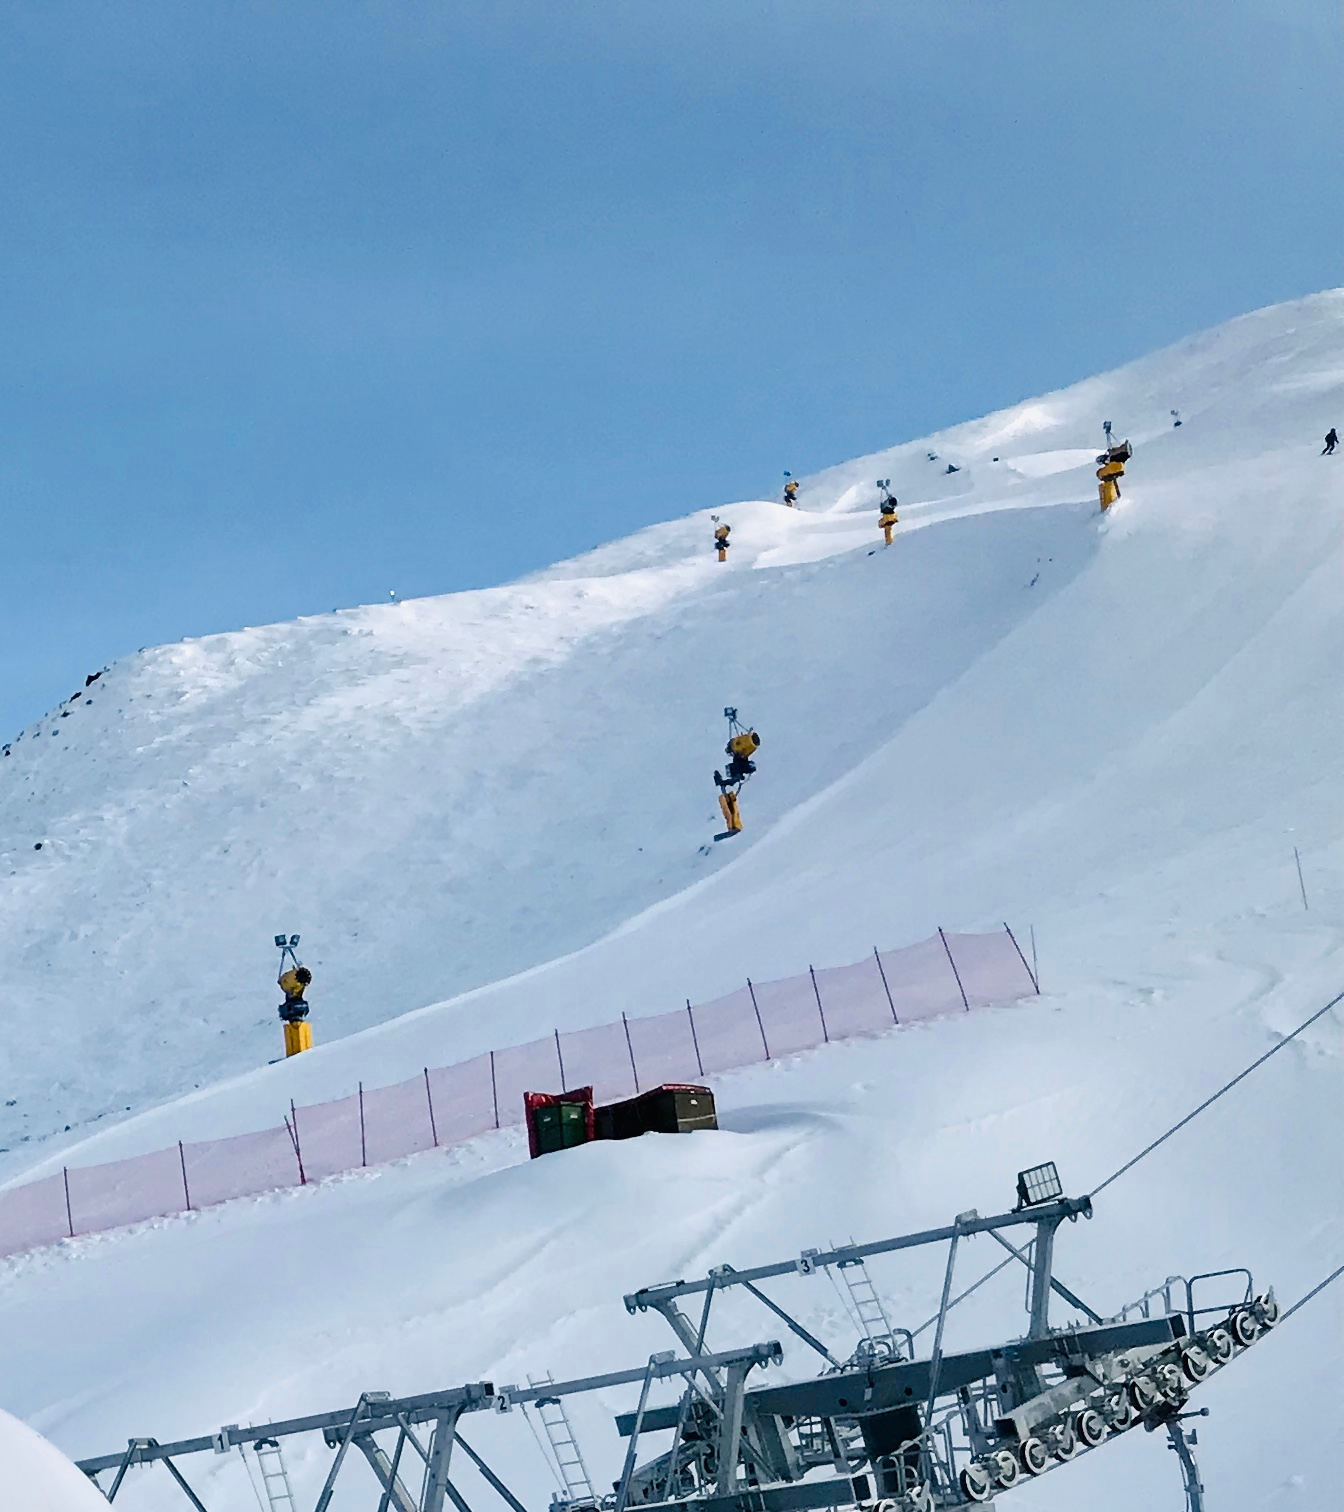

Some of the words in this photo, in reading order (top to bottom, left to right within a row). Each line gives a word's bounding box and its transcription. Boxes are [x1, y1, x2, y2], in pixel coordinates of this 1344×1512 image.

[801, 1259, 811, 1273] 3
[497, 1395, 508, 1411] 2
[217, 1433, 225, 1450] 1
